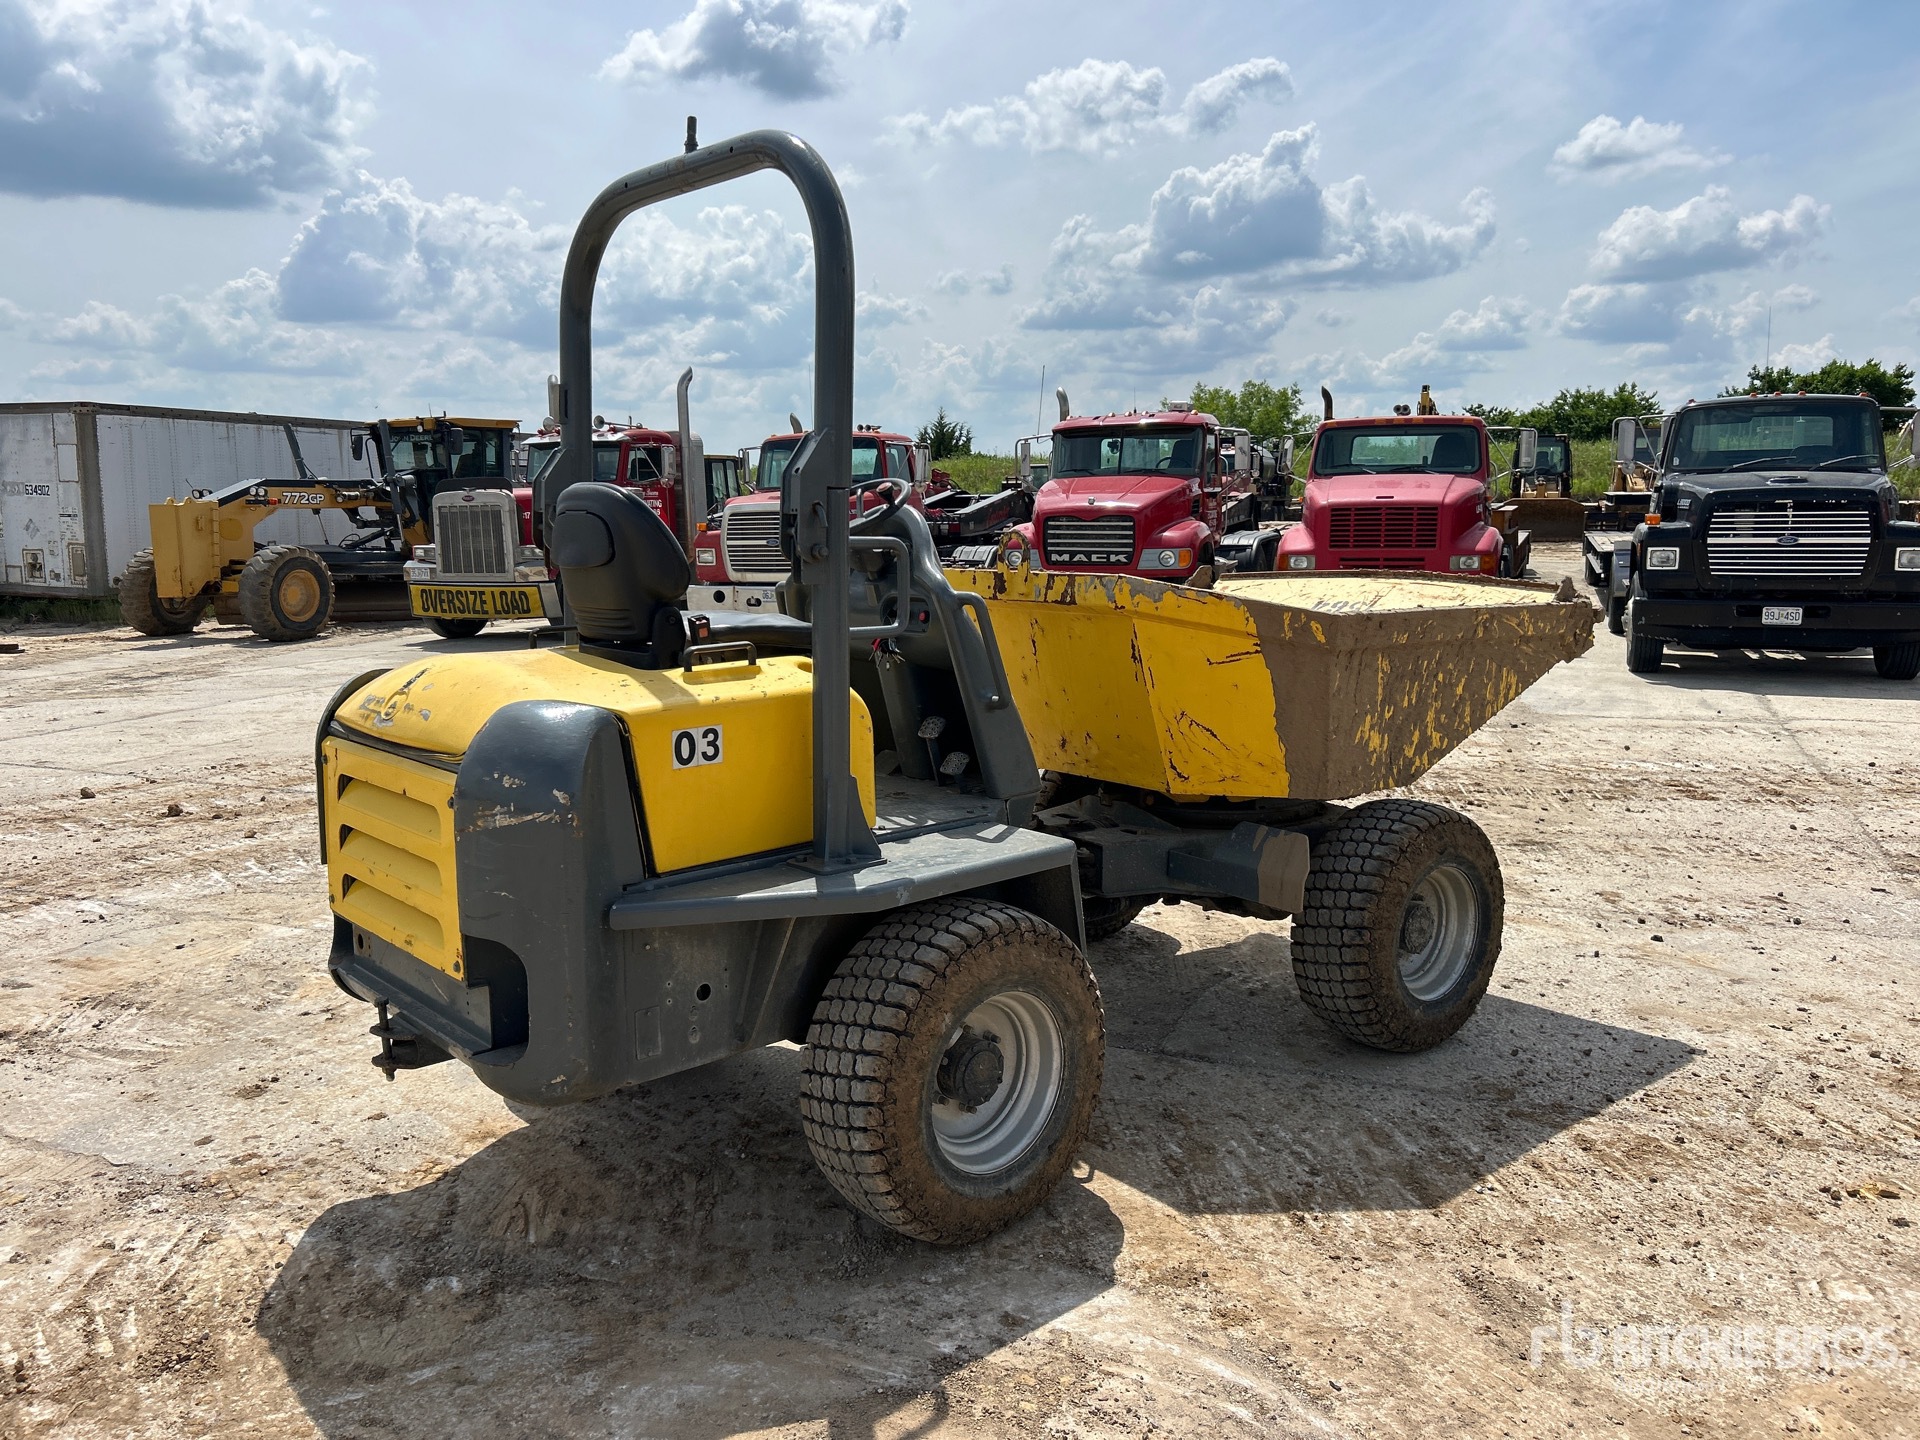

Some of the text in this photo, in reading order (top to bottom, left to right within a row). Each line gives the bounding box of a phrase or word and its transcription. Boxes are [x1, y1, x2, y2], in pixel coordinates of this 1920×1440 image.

[24, 484, 51, 496] 634902
[282, 491, 325, 505] 772GP
[1051, 553, 1129, 563] MACK
[420, 588, 531, 615] OVERSIZE LOAD
[674, 727, 720, 766] 03
